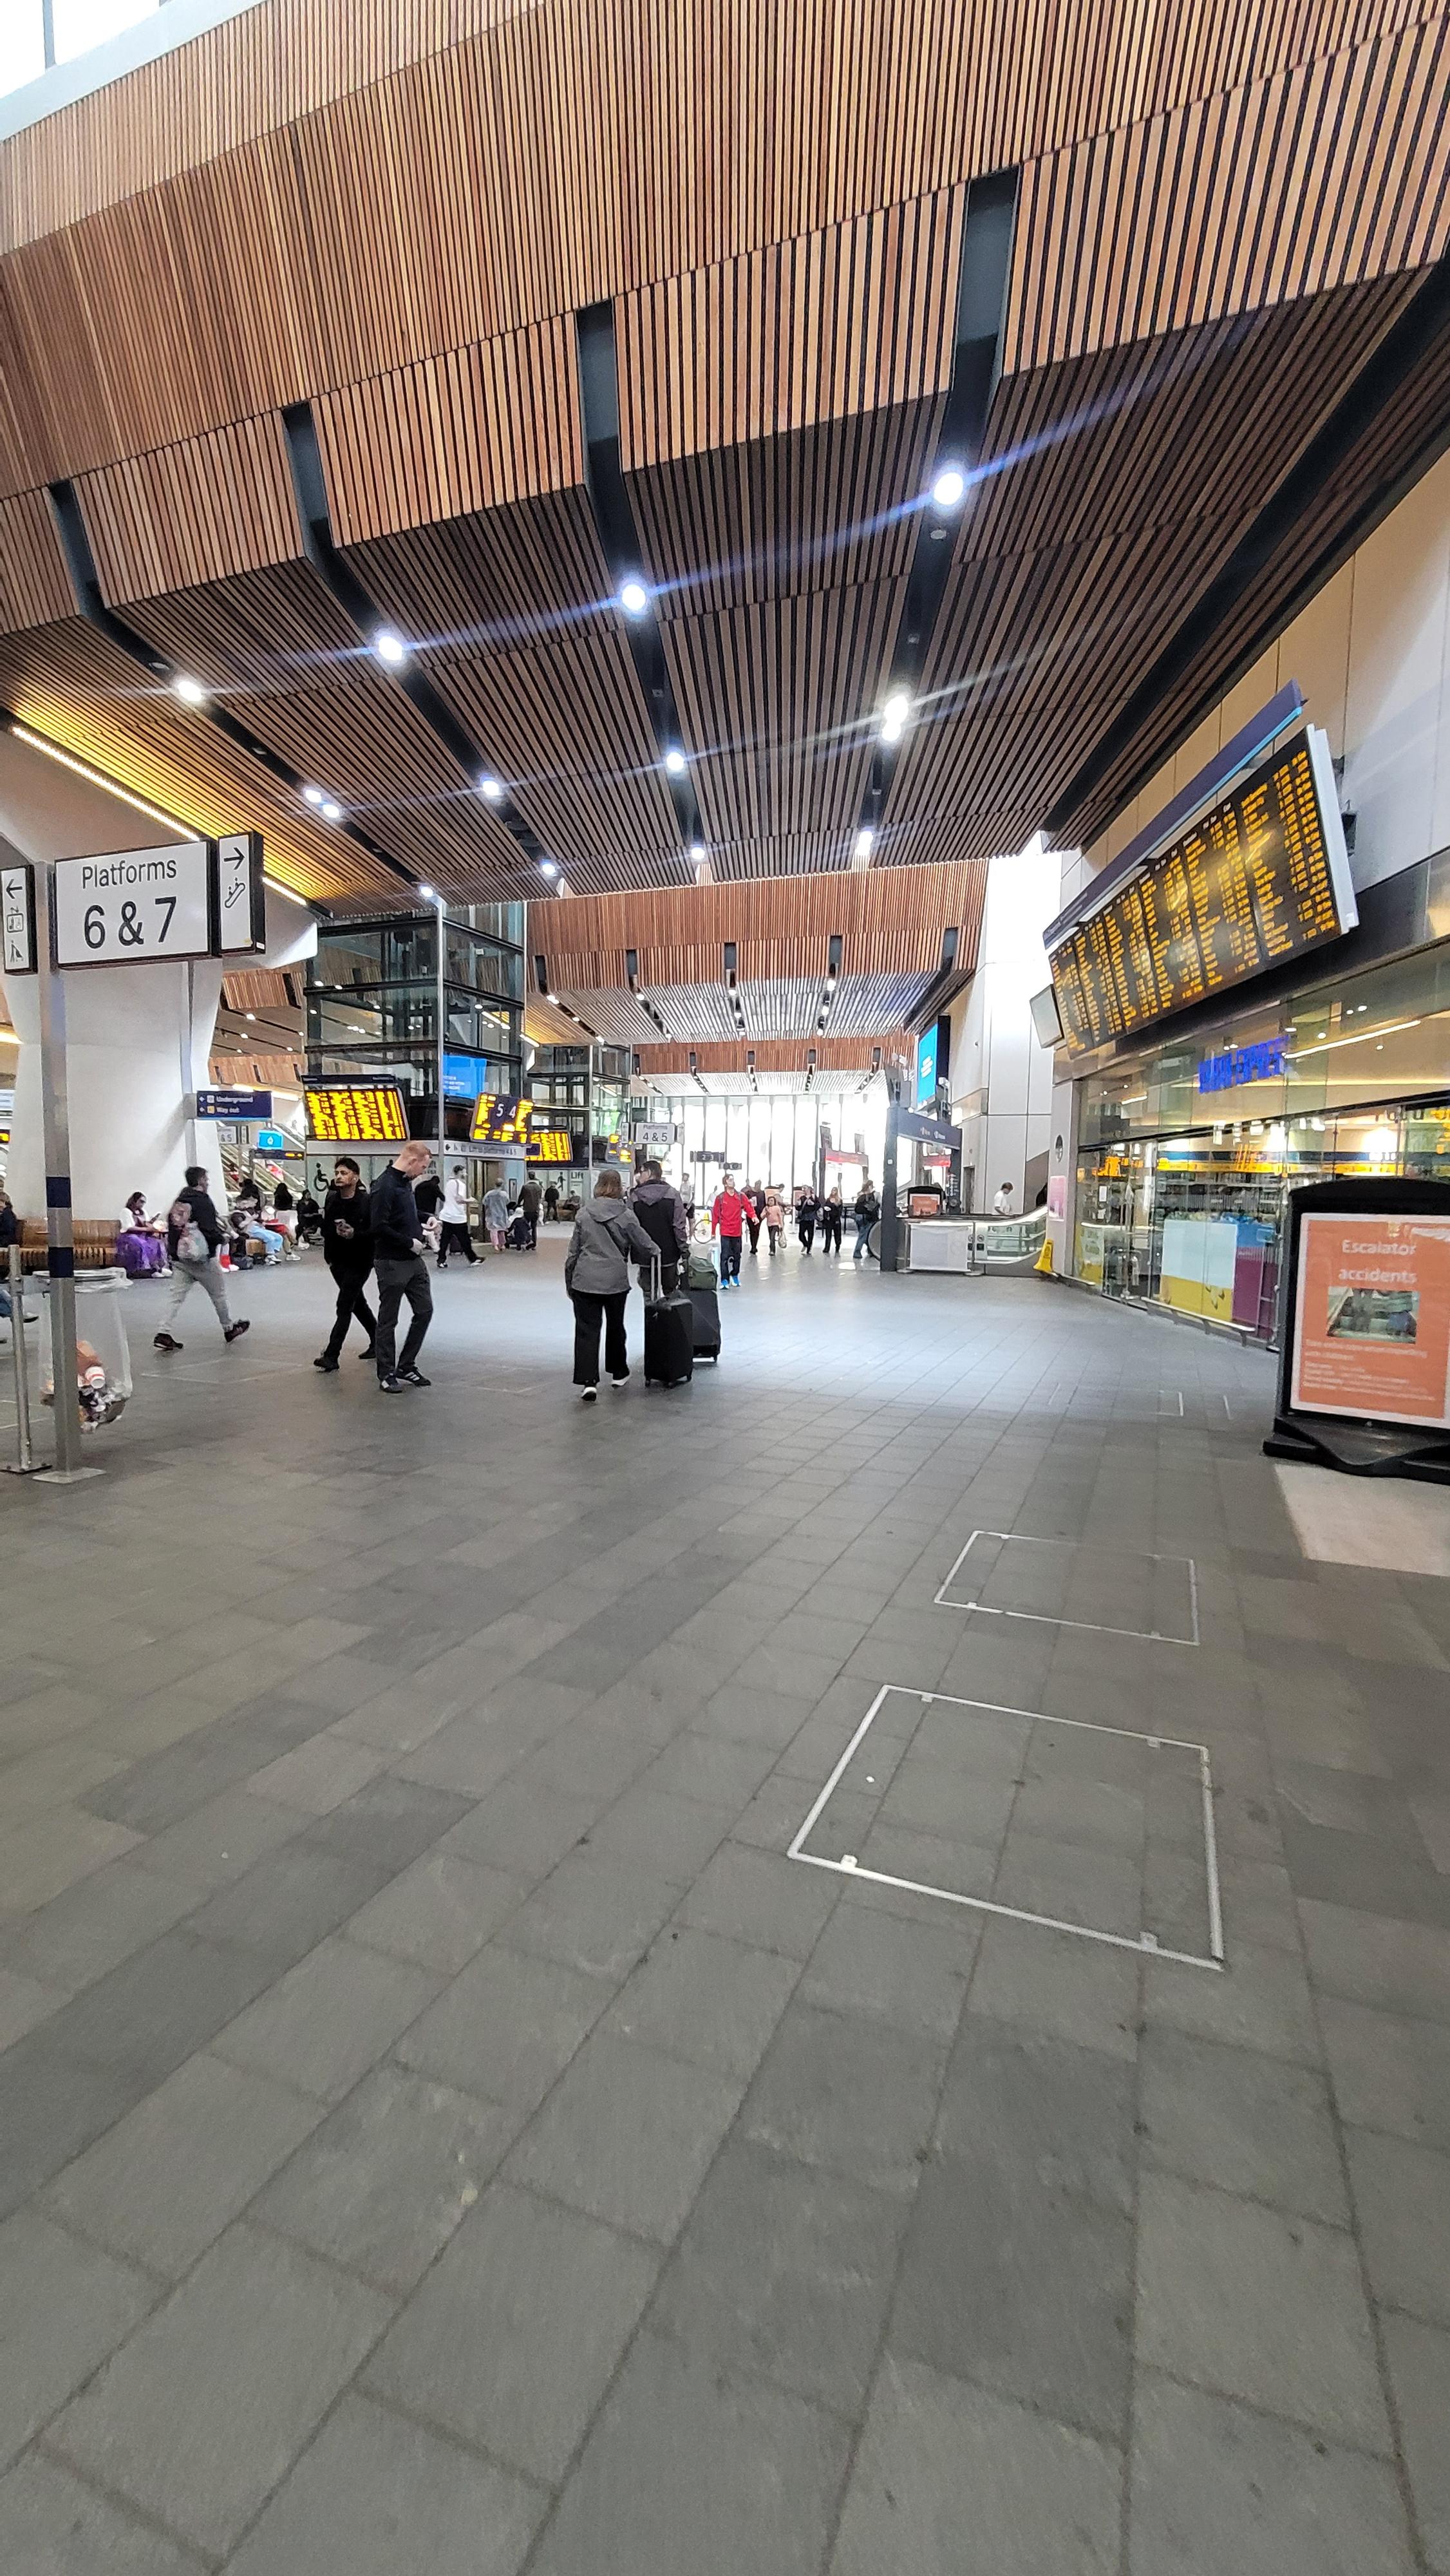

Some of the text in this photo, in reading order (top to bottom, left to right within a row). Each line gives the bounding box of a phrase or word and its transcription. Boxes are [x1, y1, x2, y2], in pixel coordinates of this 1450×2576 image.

[82, 860, 177, 889] Platforms
[84, 896, 177, 949] 6 & 7
[496, 1103, 516, 1119] 5 4
[643, 1132, 668, 1142] 4 & 5
[1341, 1239, 1417, 1255] Escalator
[1338, 1267, 1417, 1284] accidents
